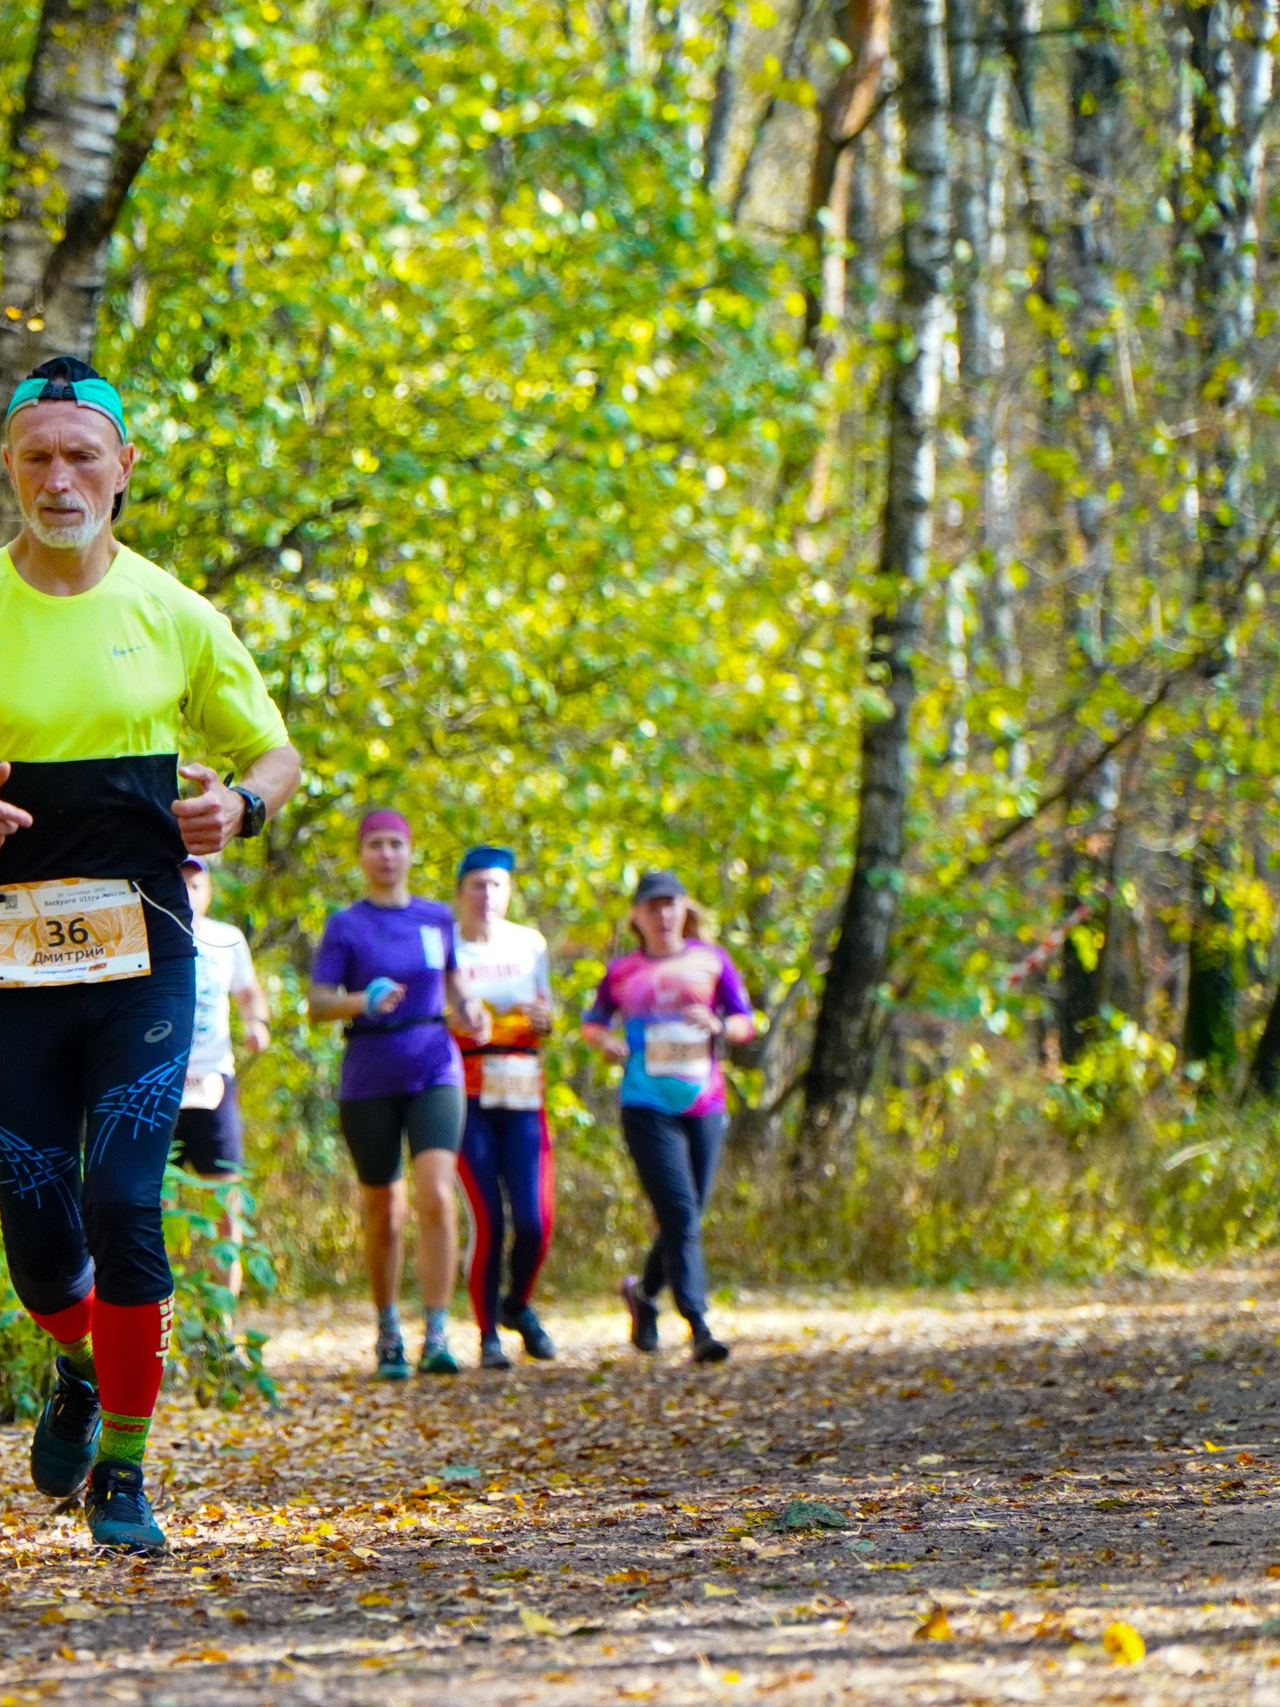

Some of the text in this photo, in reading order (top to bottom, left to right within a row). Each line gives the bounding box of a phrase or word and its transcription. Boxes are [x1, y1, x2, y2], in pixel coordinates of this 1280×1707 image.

[44, 890, 127, 907] Backyard Ultra Moscow
[46, 917, 89, 948] 36
[32, 944, 105, 965] Дмитрий
